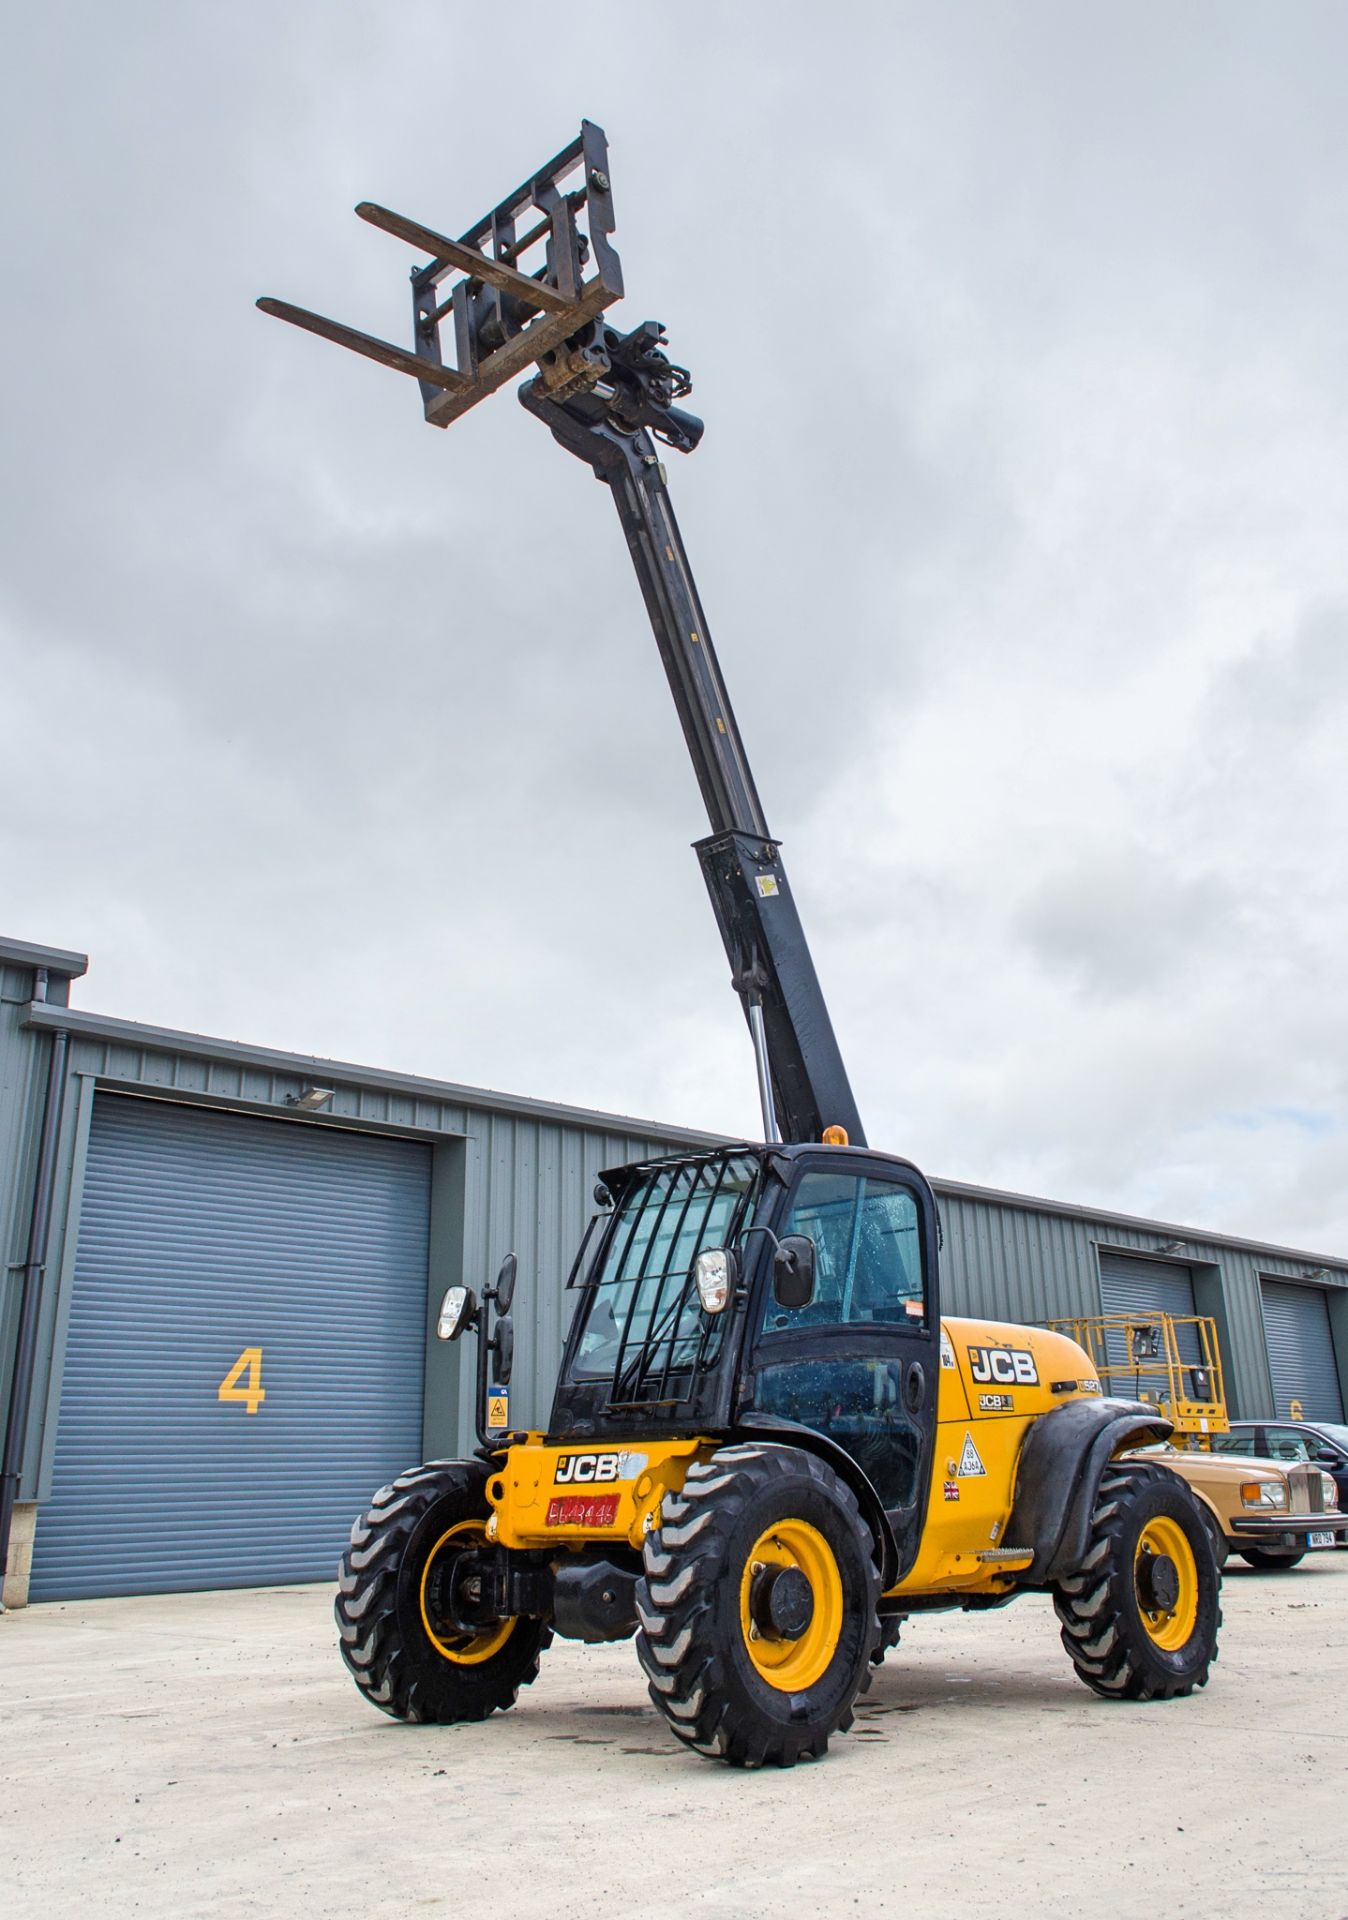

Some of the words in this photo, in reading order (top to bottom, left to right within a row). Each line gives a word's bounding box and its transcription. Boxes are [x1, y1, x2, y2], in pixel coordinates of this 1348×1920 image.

[217, 1348, 266, 1414] 4
[971, 1348, 1038, 1383] JCB
[979, 1395, 1002, 1407] JCB
[556, 1454, 619, 1483] JCB
